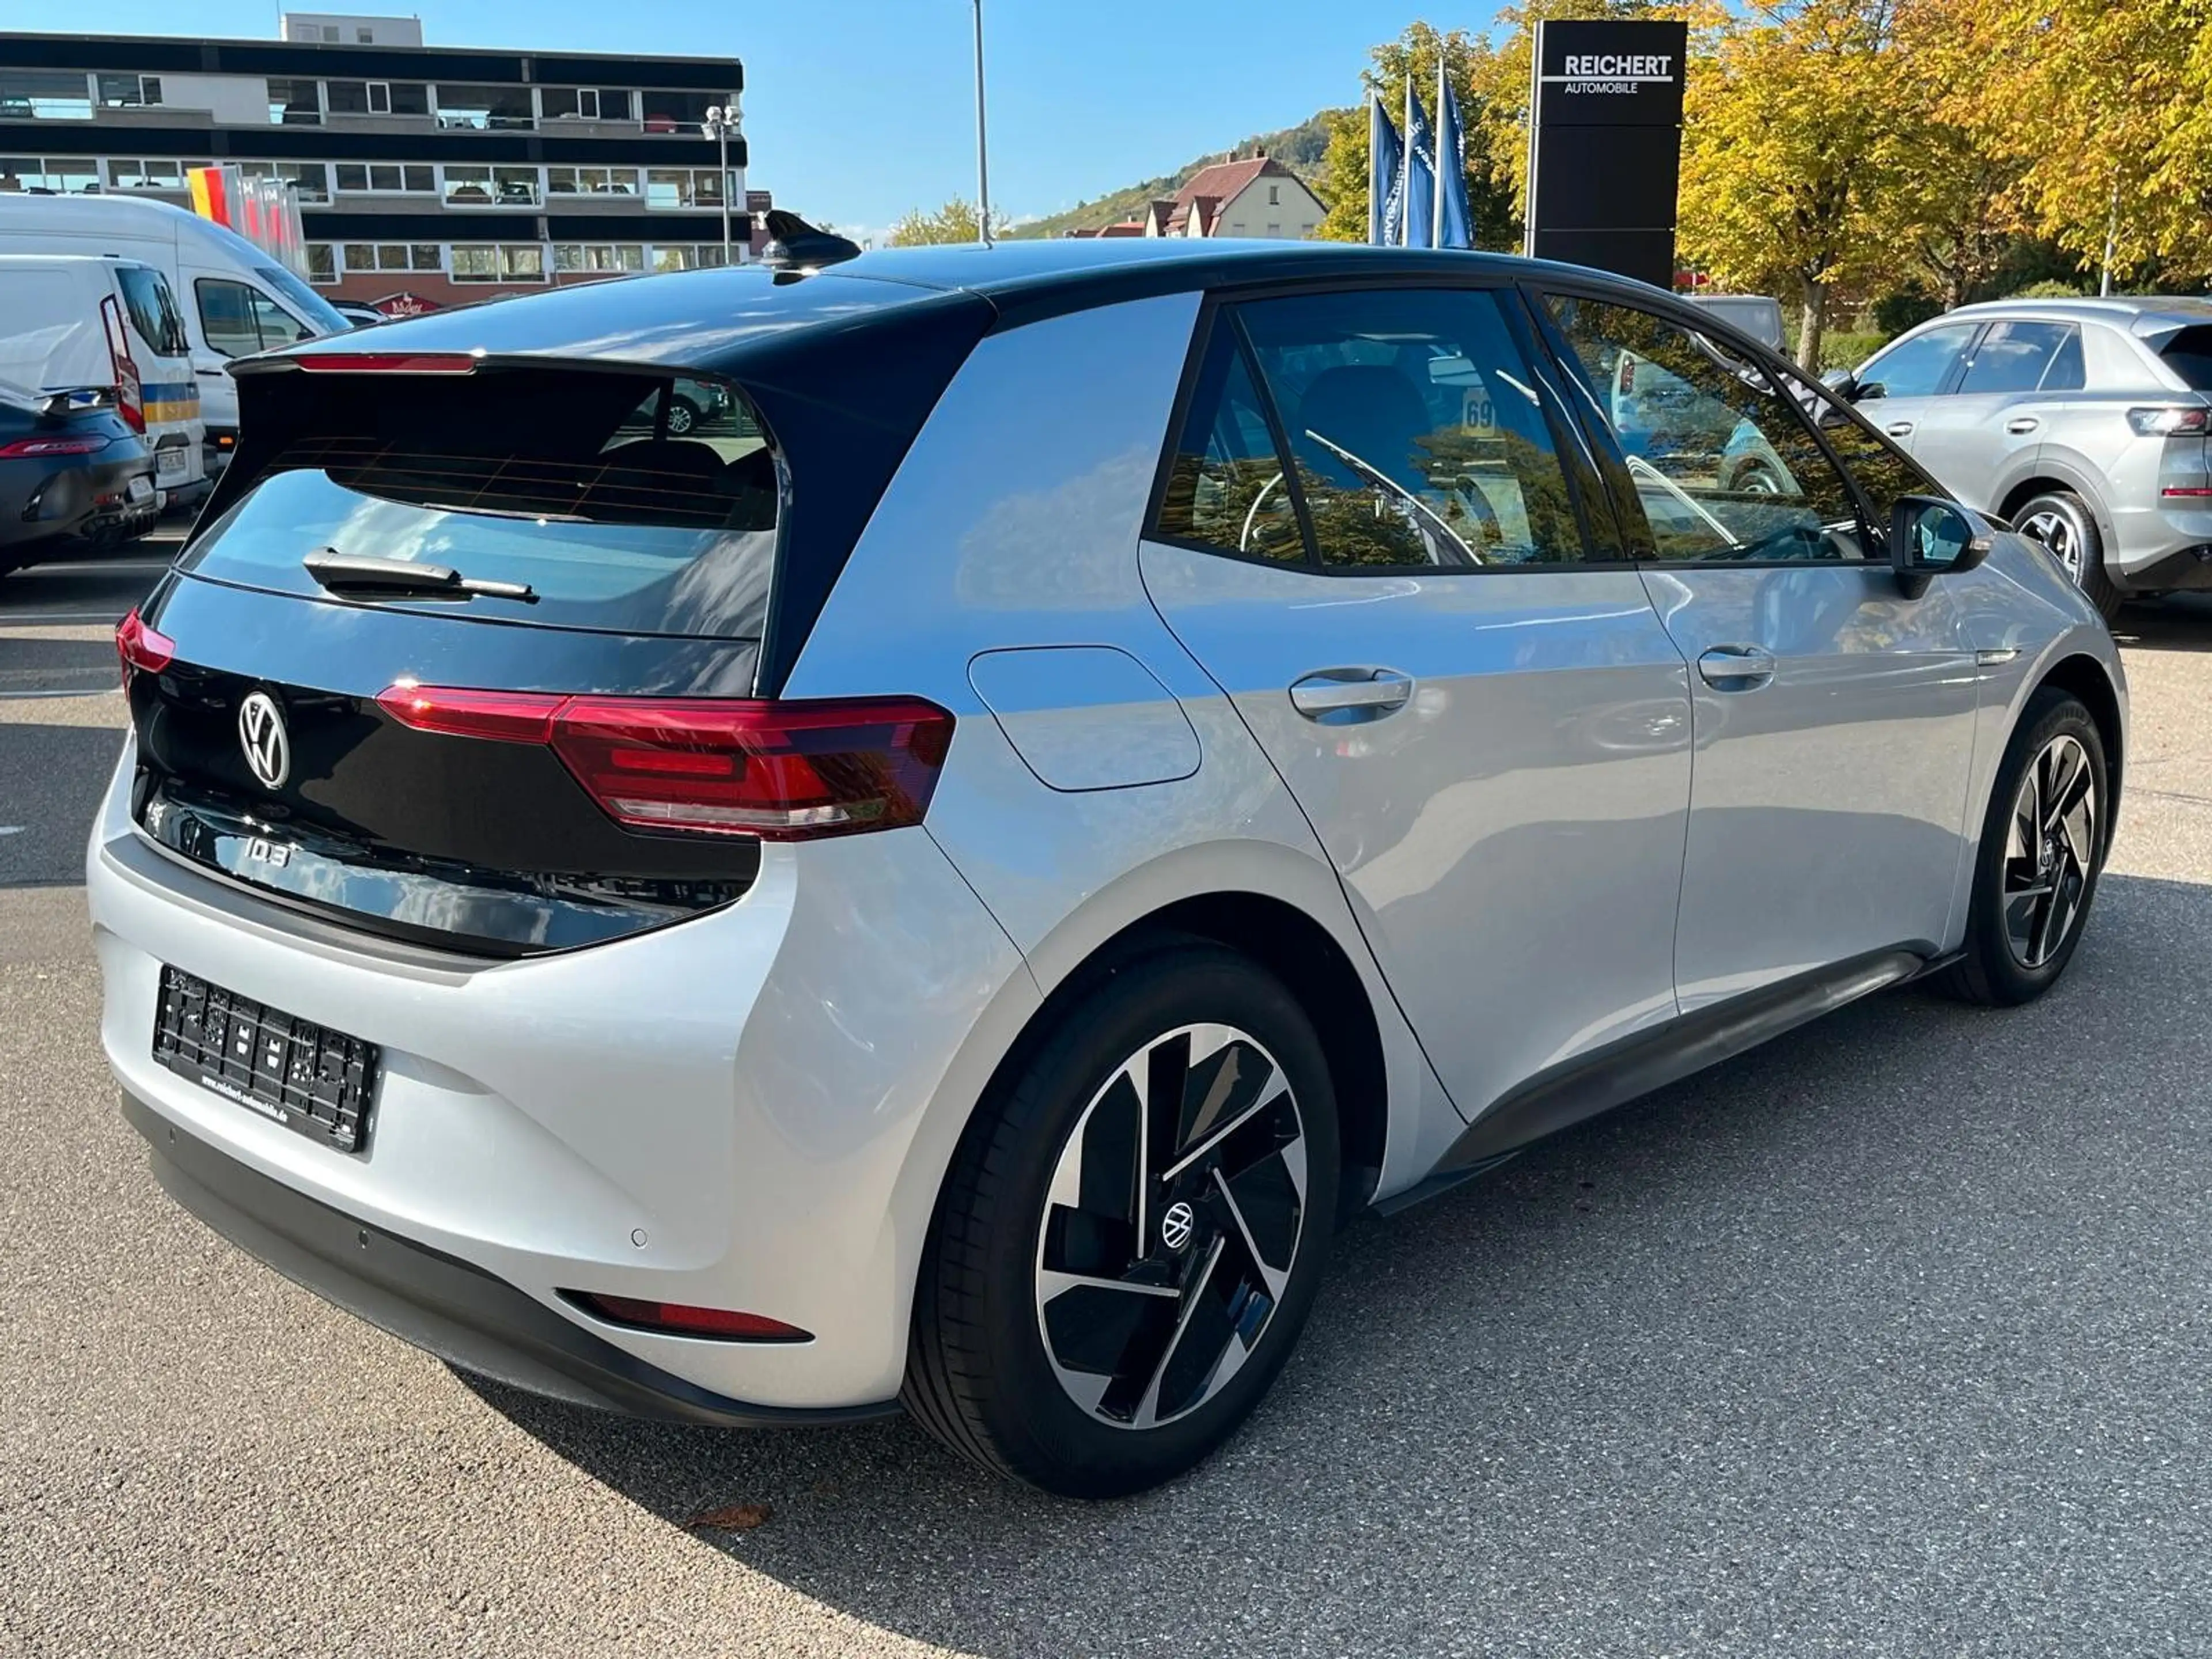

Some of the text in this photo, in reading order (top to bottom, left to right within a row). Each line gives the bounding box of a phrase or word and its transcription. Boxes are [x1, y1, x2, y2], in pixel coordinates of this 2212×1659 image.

[1565, 55, 1672, 75] REICHERT
[1565, 82, 1638, 94] AUTOMOBILE
[1466, 400, 1493, 428] 69
